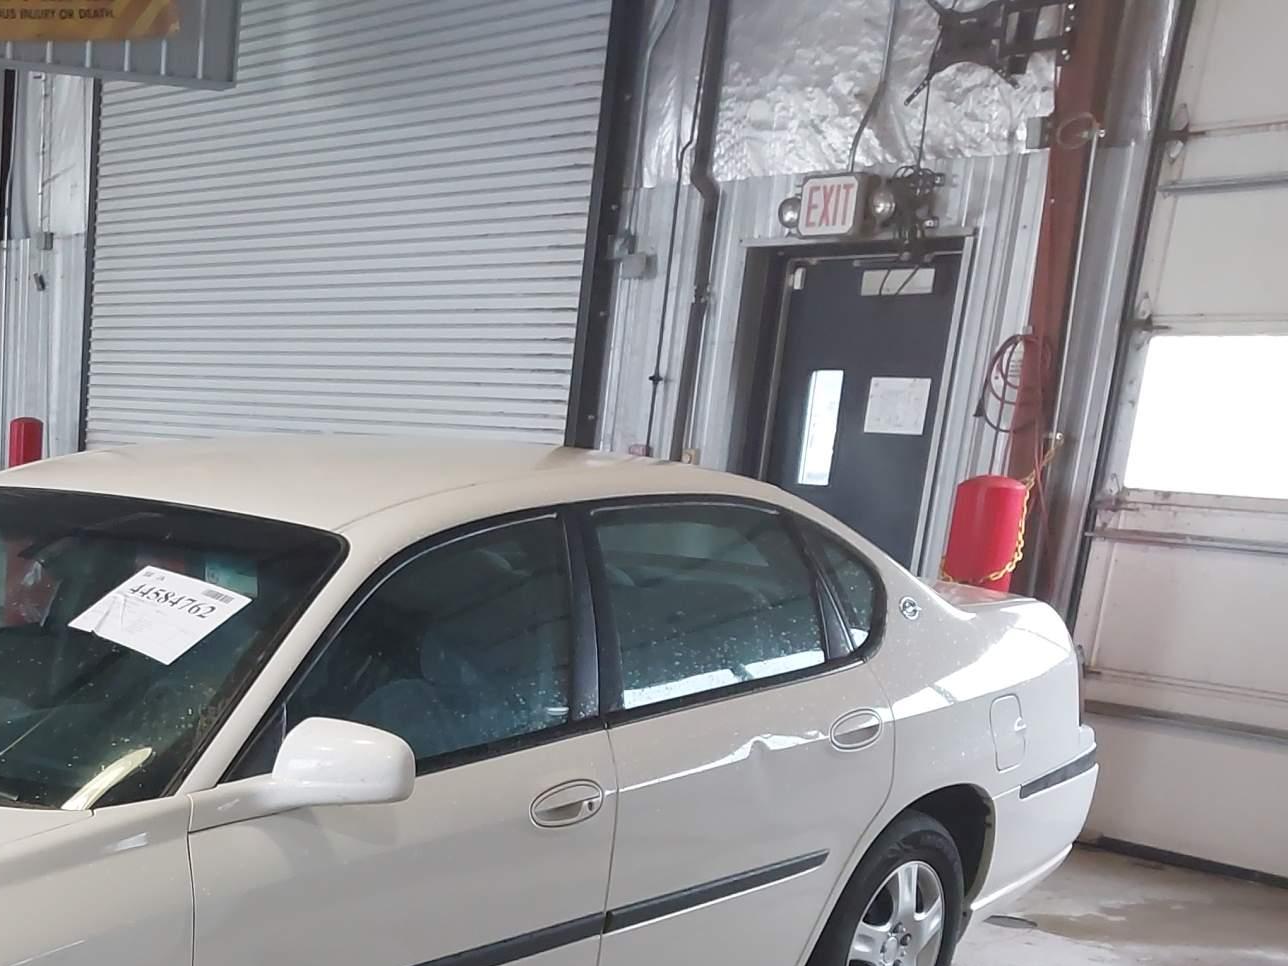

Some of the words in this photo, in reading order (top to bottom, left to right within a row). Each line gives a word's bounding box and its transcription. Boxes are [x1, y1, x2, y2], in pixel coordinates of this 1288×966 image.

[20, 8, 56, 19] INJURY
[58, 8, 75, 19] OR
[805, 183, 854, 228] EXIT
[129, 583, 217, 619] 44584762
